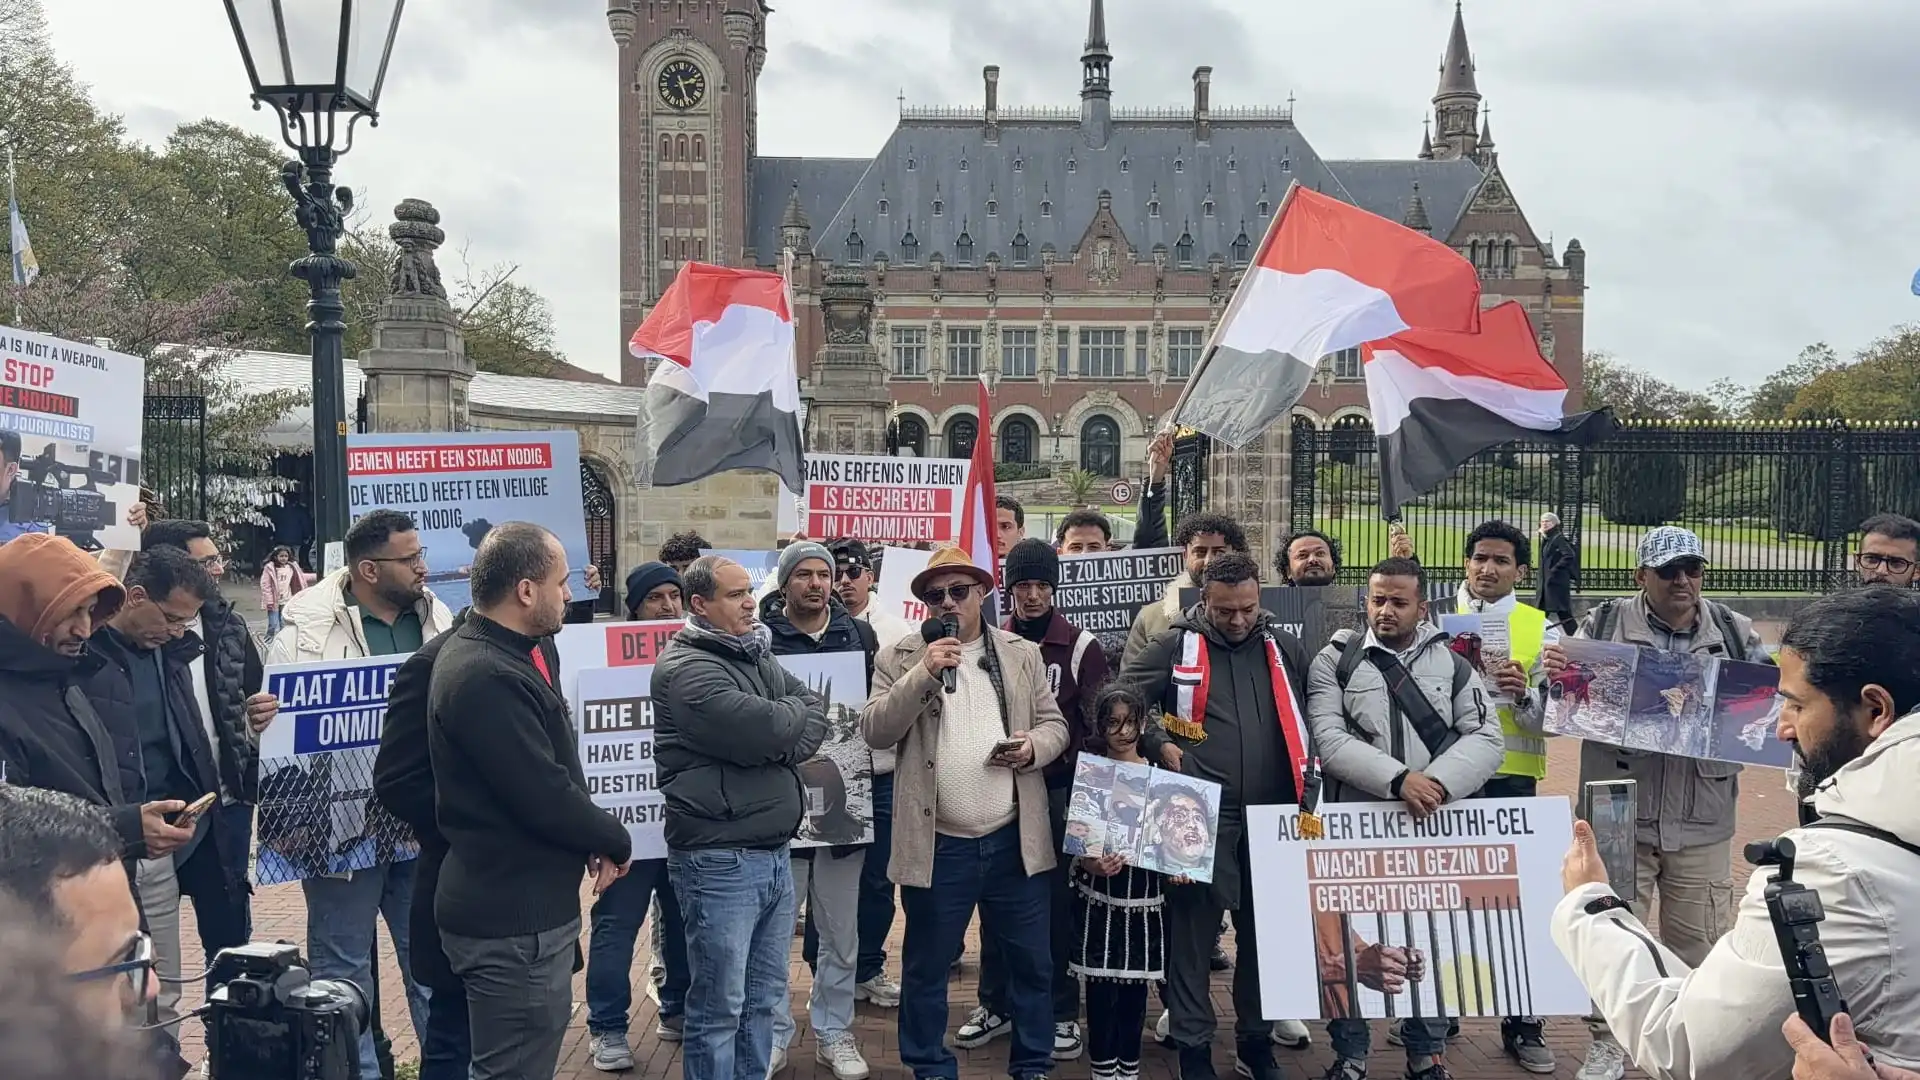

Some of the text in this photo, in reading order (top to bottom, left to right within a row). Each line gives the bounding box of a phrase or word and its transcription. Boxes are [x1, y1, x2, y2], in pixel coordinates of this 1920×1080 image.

[11, 338, 22, 353] IS
[26, 341, 48, 358] NOT
[52, 346, 58, 360] A
[62, 348, 108, 371] WEAPON.
[5, 358, 54, 387] STOP
[18, 389, 74, 416] HOUTHI
[13, 414, 91, 440] JOURNALISTS
[348, 447, 546, 471] JEMEN HEEFT EEN STAAT NODIG,
[844, 461, 904, 484] ERFENIS
[908, 463, 922, 484] IN
[925, 464, 963, 485] JEMEN
[351, 477, 549, 506] DE WERELD HEEFT EEN VEILIGE
[823, 487, 936, 511] IS GESCHREVEN
[1116, 488, 1128, 498] 15
[422, 508, 462, 531] NODIG
[822, 515, 935, 539] IN LANDMIJNEN
[1075, 558, 1132, 582] ZOLANG
[1136, 556, 1155, 578] DE
[1101, 583, 1150, 605] STEDEN
[903, 600, 930, 621] TH
[1061, 609, 1131, 631] EHEERSEN
[622, 632, 648, 660] DE
[279, 673, 337, 708] LAAT
[585, 703, 633, 730] THE
[587, 743, 634, 763] HAVE
[1359, 811, 1409, 840] ELKE
[1413, 807, 1534, 838] HOUTHI-CEL
[1312, 847, 1509, 878] WACHT EEN GEZIN OP
[1315, 883, 1462, 912] GERECHTIGHEID
